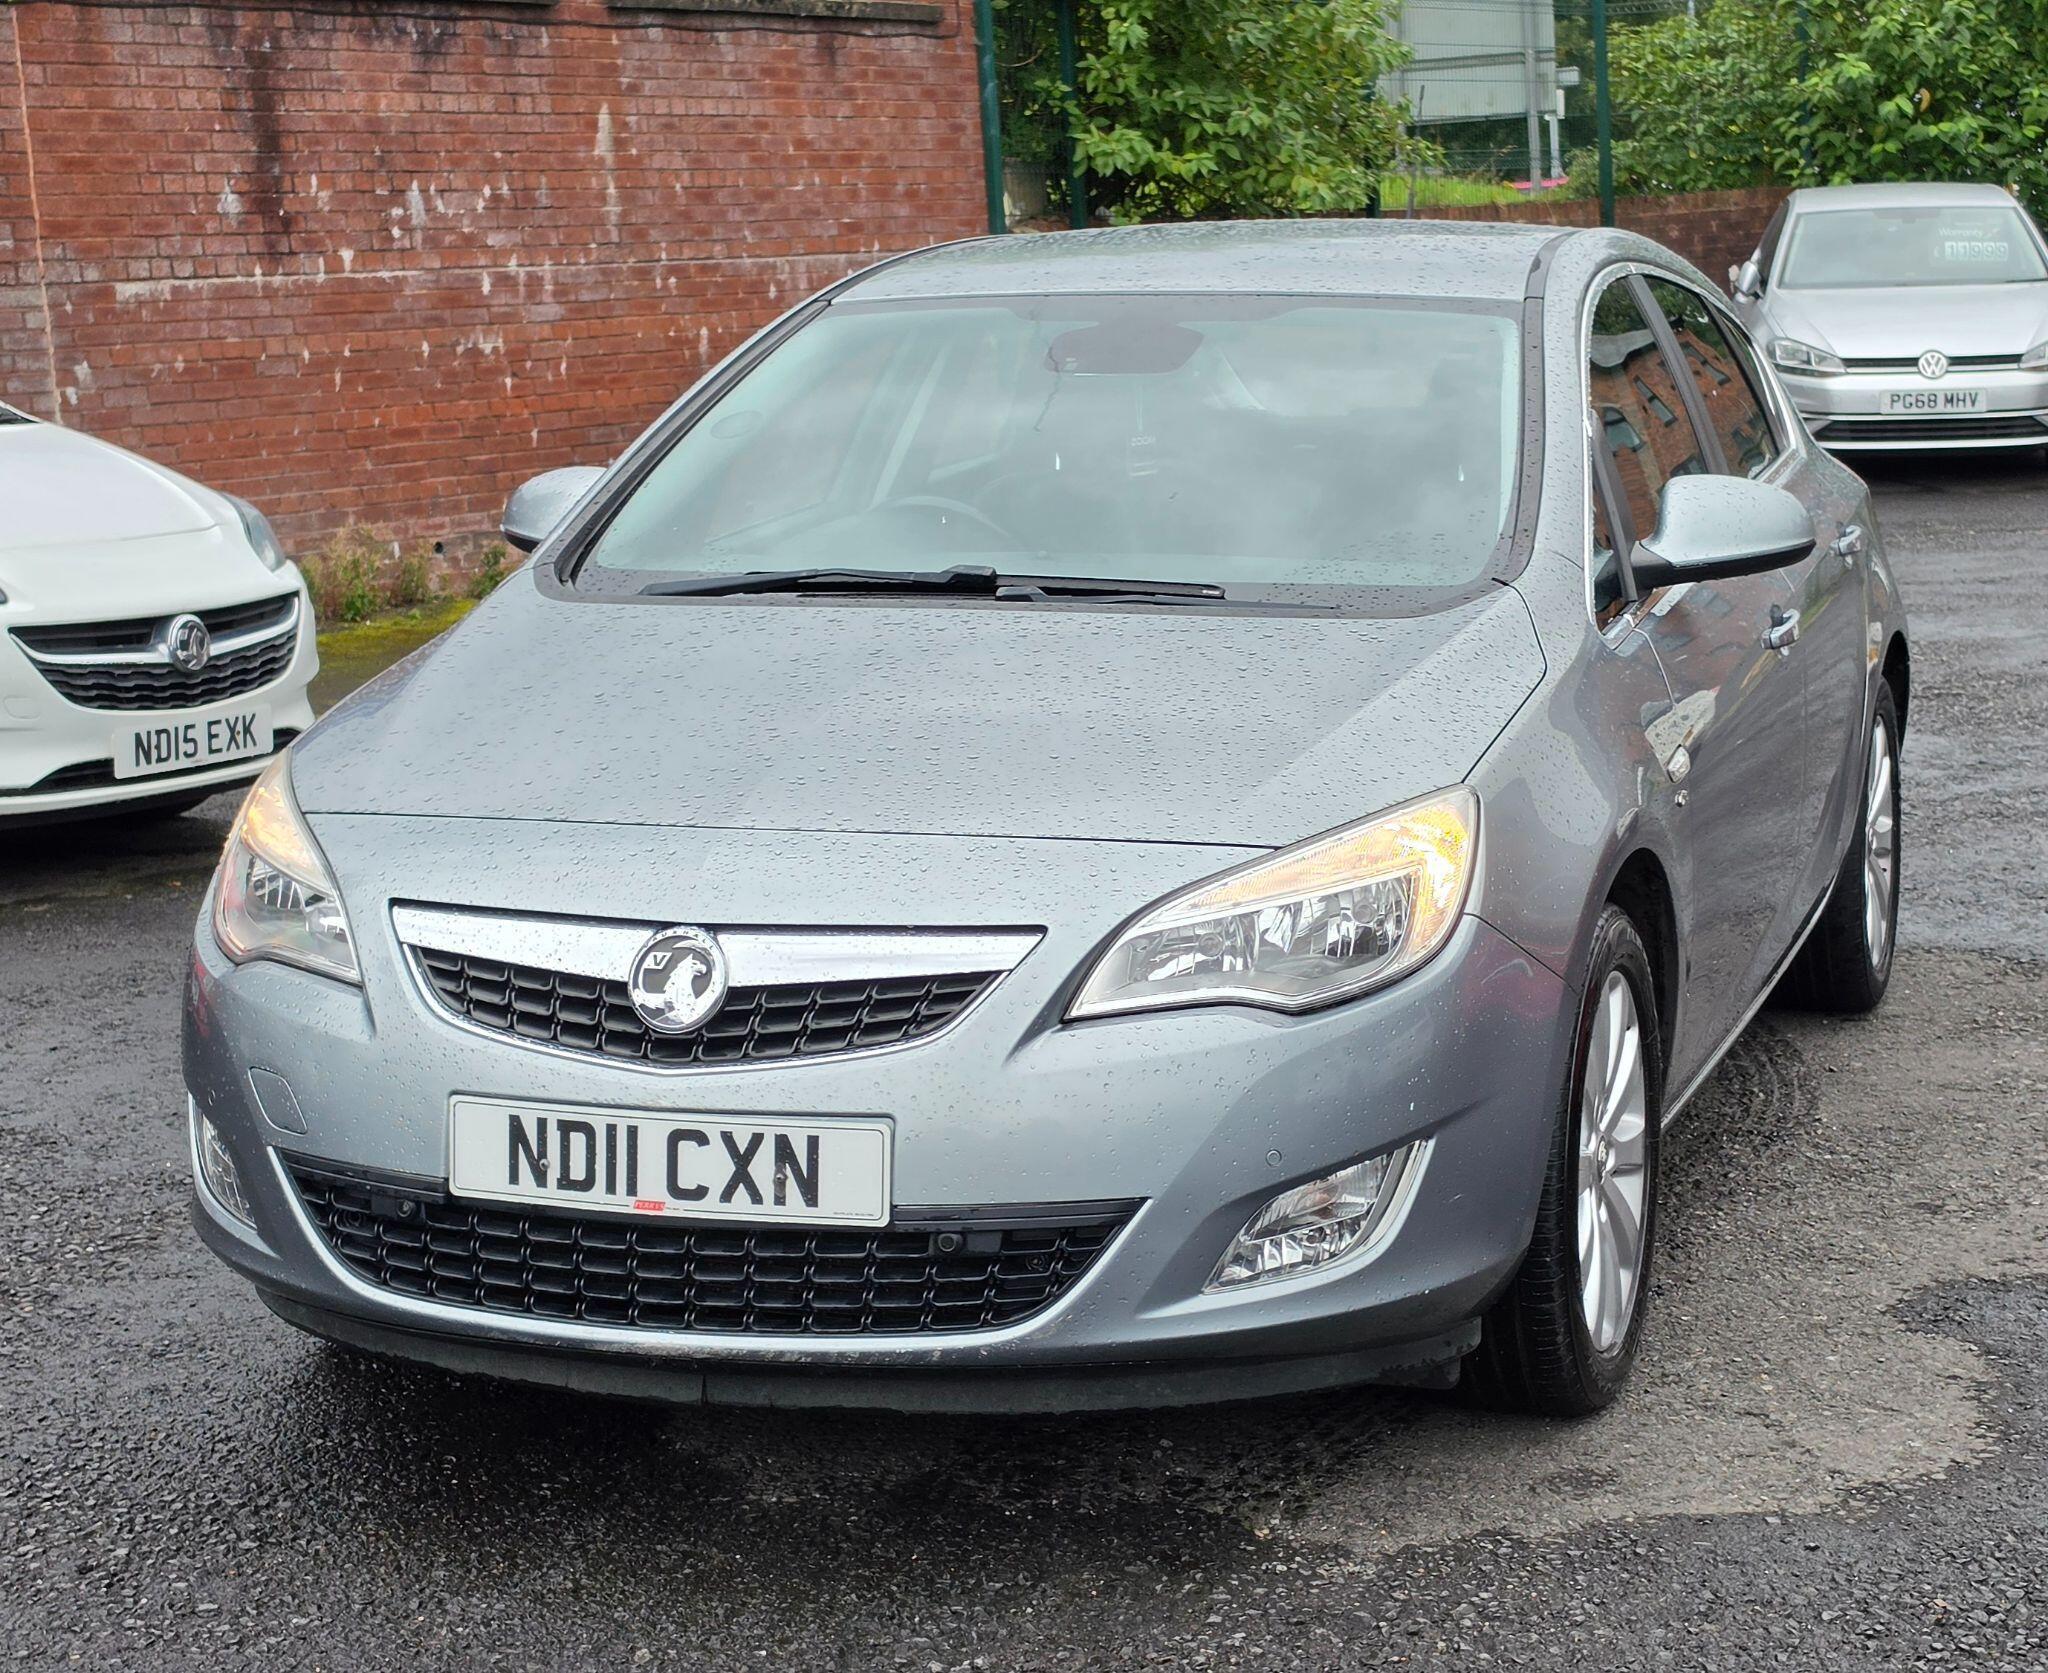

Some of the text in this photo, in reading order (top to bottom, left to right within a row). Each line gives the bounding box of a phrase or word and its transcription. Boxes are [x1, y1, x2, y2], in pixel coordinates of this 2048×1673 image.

[1938, 227, 1984, 239] Warranty
[1890, 391, 1979, 409] PG68 MHV
[134, 713, 257, 767] ND15 EXK
[508, 1114, 821, 1208] ND11 CXN
